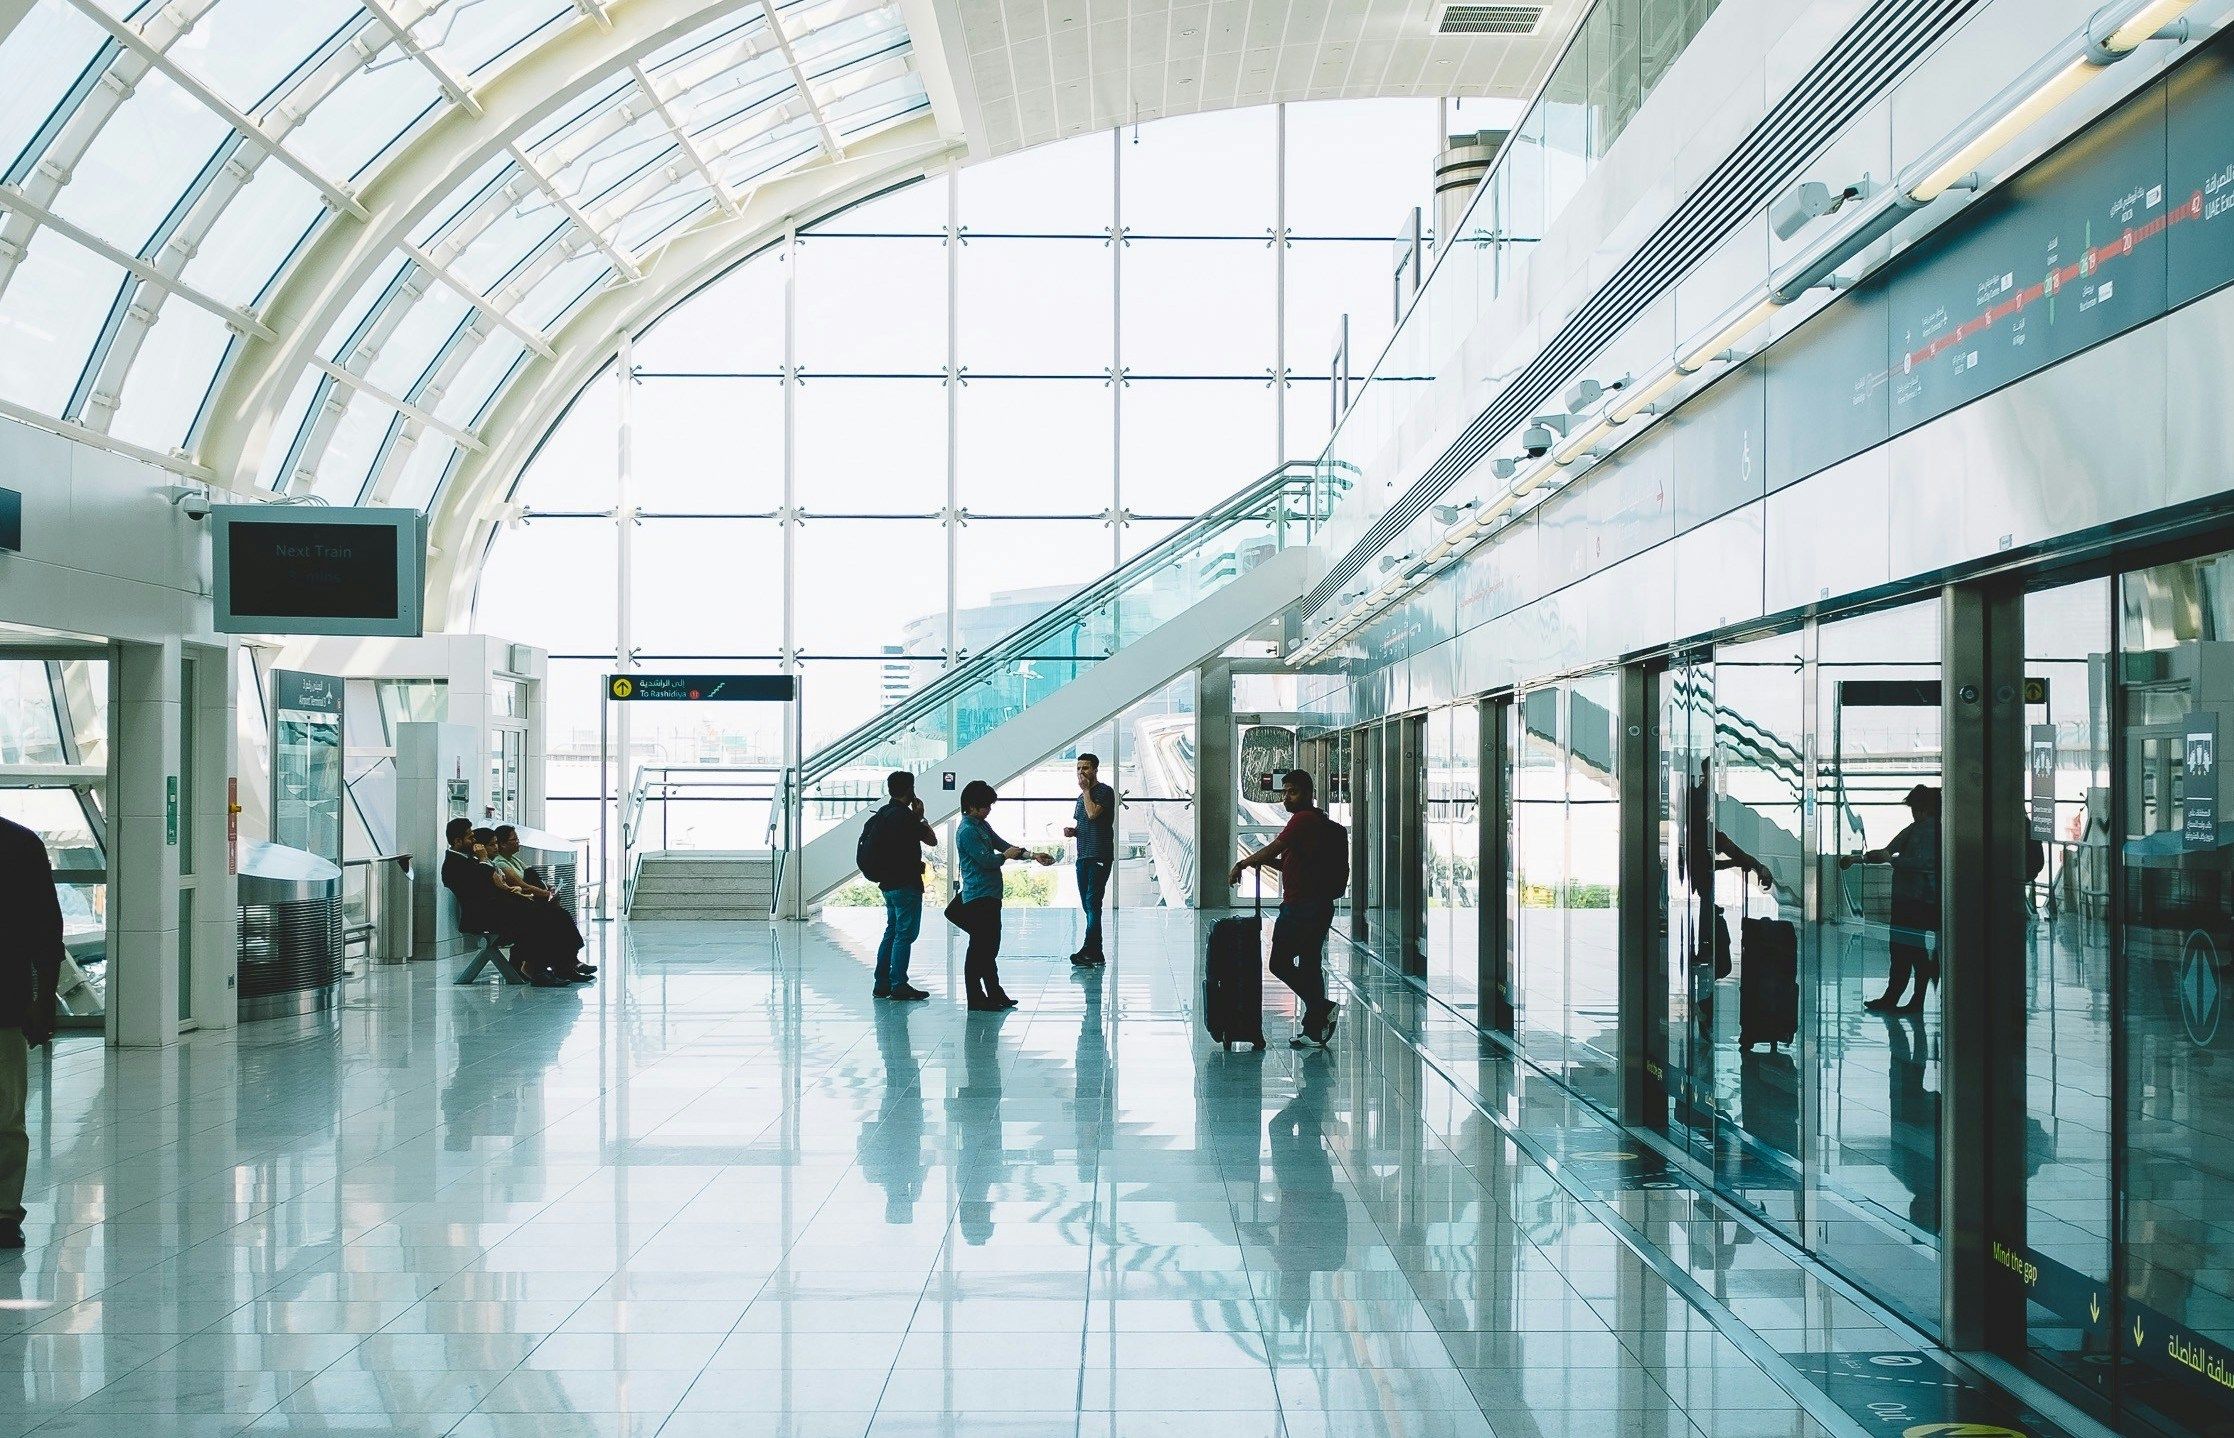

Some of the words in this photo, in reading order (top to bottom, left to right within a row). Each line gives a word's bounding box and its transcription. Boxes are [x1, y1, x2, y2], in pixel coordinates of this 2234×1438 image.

[2205, 196, 2220, 221] UAE
[2122, 232, 2132, 252] 20
[276, 543, 310, 558] Next
[314, 544, 352, 559] Train
[640, 679, 670, 689] الراشدية
[640, 689, 649, 698] To
[650, 689, 687, 698] Rashidiya
[671, 678, 686, 689] إلى
[1993, 1241, 2010, 1267] Mind
[2011, 1250, 2023, 1274] the
[2024, 1262, 2038, 1287] gap
[2168, 1334, 2205, 1373] الفاصلة
[1867, 1402, 1917, 1422] Out
